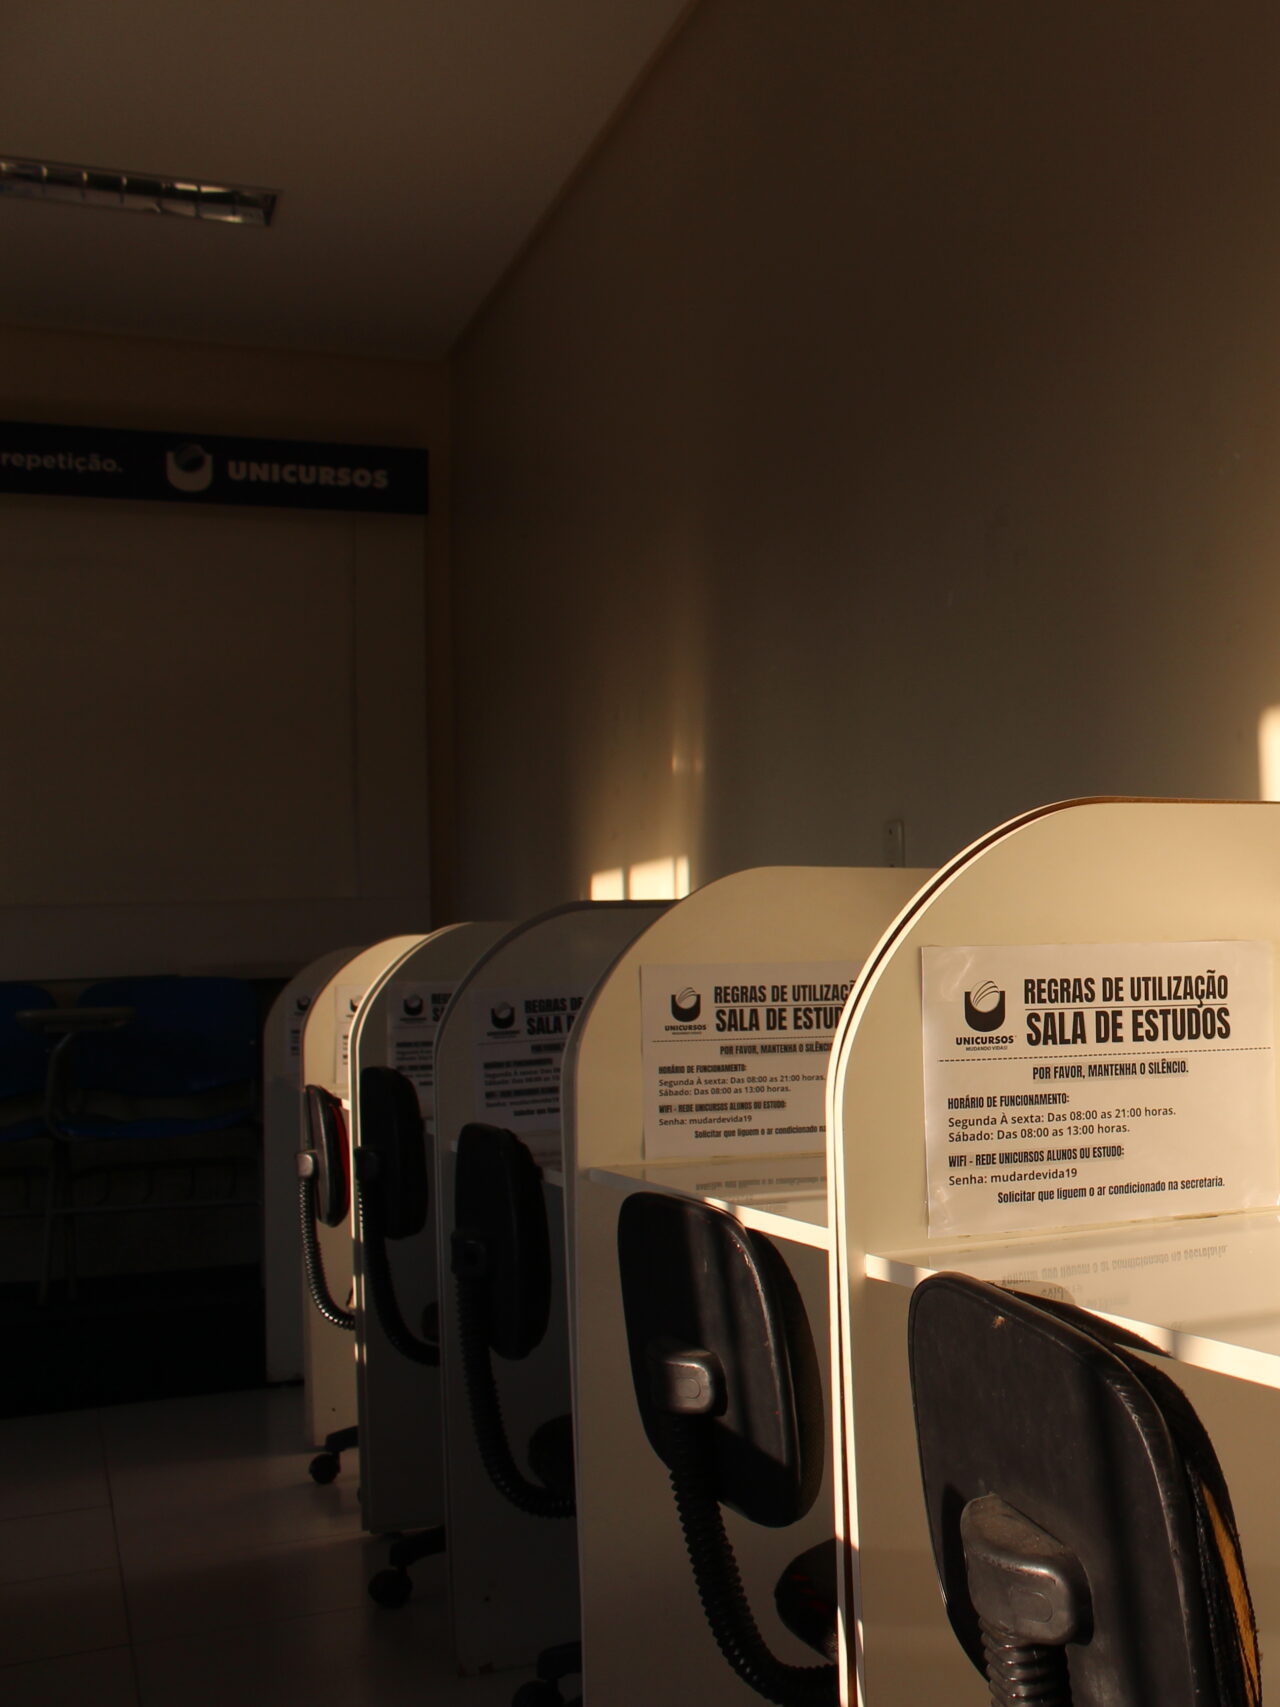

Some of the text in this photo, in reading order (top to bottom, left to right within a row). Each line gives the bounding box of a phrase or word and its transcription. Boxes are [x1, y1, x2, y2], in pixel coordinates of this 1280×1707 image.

[0, 452, 124, 474] repetição.
[227, 460, 389, 489] UNICURSOS
[714, 979, 855, 1005] REGRAS DE UTILIZAÇ
[1024, 969, 1228, 1008] REGRAS DE UTILIZAÇÃO
[526, 1015, 563, 1035] SALA
[664, 1024, 707, 1032] UNICURSOS
[715, 1006, 844, 1033] SALA DE ESTUD
[1026, 1007, 1231, 1046] SALA DE ESTUDOS
[719, 1045, 734, 1056] POR
[735, 1044, 759, 1056] FAVOR,
[760, 1043, 797, 1054] MANTENHA
[805, 1041, 832, 1052] SILÊNCI
[955, 1035, 1014, 1046] UNICURSOS
[1032, 1058, 1189, 1080] POR FAVOR, MANTENHA O SILÊNCIO.
[658, 1078, 694, 1088] Segunda
[704, 1077, 728, 1085] sexta:
[730, 1076, 745, 1084] Das
[746, 1076, 768, 1084] 08:00
[780, 1074, 801, 1082] 21:00
[801, 1073, 826, 1082] horas.
[658, 1088, 692, 1097] Sábado:
[693, 1088, 709, 1096] Das
[710, 1087, 732, 1095] 08:00
[744, 1086, 765, 1094] 13:00
[766, 1085, 791, 1093] horas.
[947, 1092, 1070, 1110] HORÁRIO DE FUNCIONAMENTO:
[658, 1115, 752, 1126] Senha: mudardevida19
[948, 1105, 1177, 1130] Segunda À sexta: Das 08:00 as 21:00 horas.
[694, 1129, 722, 1139] Solicitar
[723, 1129, 736, 1138] que
[774, 1125, 818, 1135] condicionado
[948, 1123, 1130, 1143] Sábado: Das 08:00 as 13:00 horas.
[948, 1155, 967, 1168] WIFI
[975, 1153, 997, 1166] REDE
[998, 1150, 1045, 1165] UNICURSOS
[1046, 1148, 1077, 1162] ALUNOS
[1079, 1147, 1091, 1159] OU
[1092, 1145, 1125, 1159] ESTUDO:
[949, 1168, 1078, 1186] Senha: mudardevida19
[997, 1175, 1225, 1204] Solicitar que liguem o ar condicionado na secretaria.
